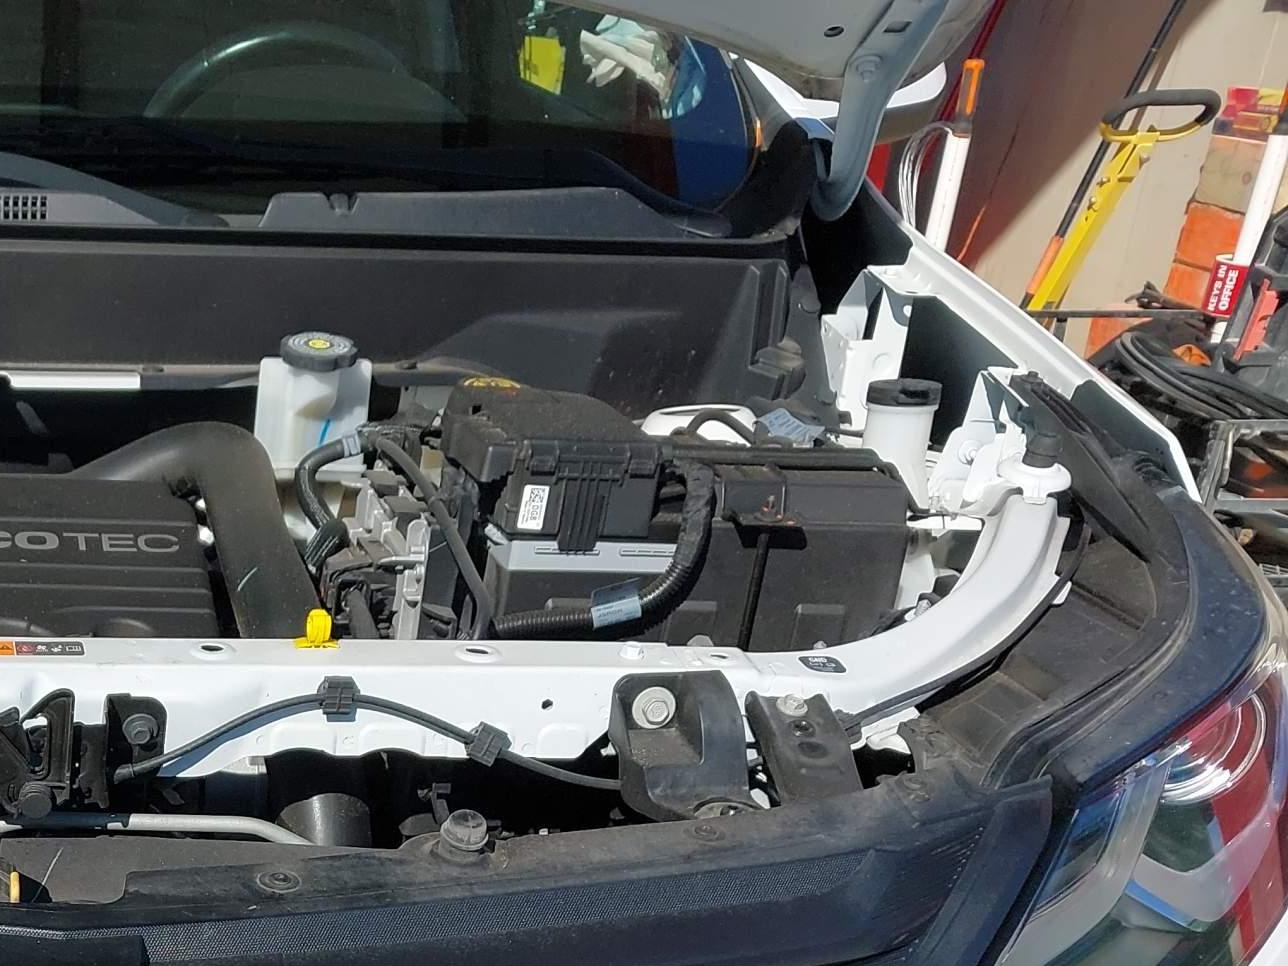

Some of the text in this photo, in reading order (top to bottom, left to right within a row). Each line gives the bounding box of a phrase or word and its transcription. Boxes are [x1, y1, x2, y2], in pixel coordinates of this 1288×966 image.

[1208, 265, 1228, 311] KEYS IN
[1218, 269, 1239, 311] OFFICE
